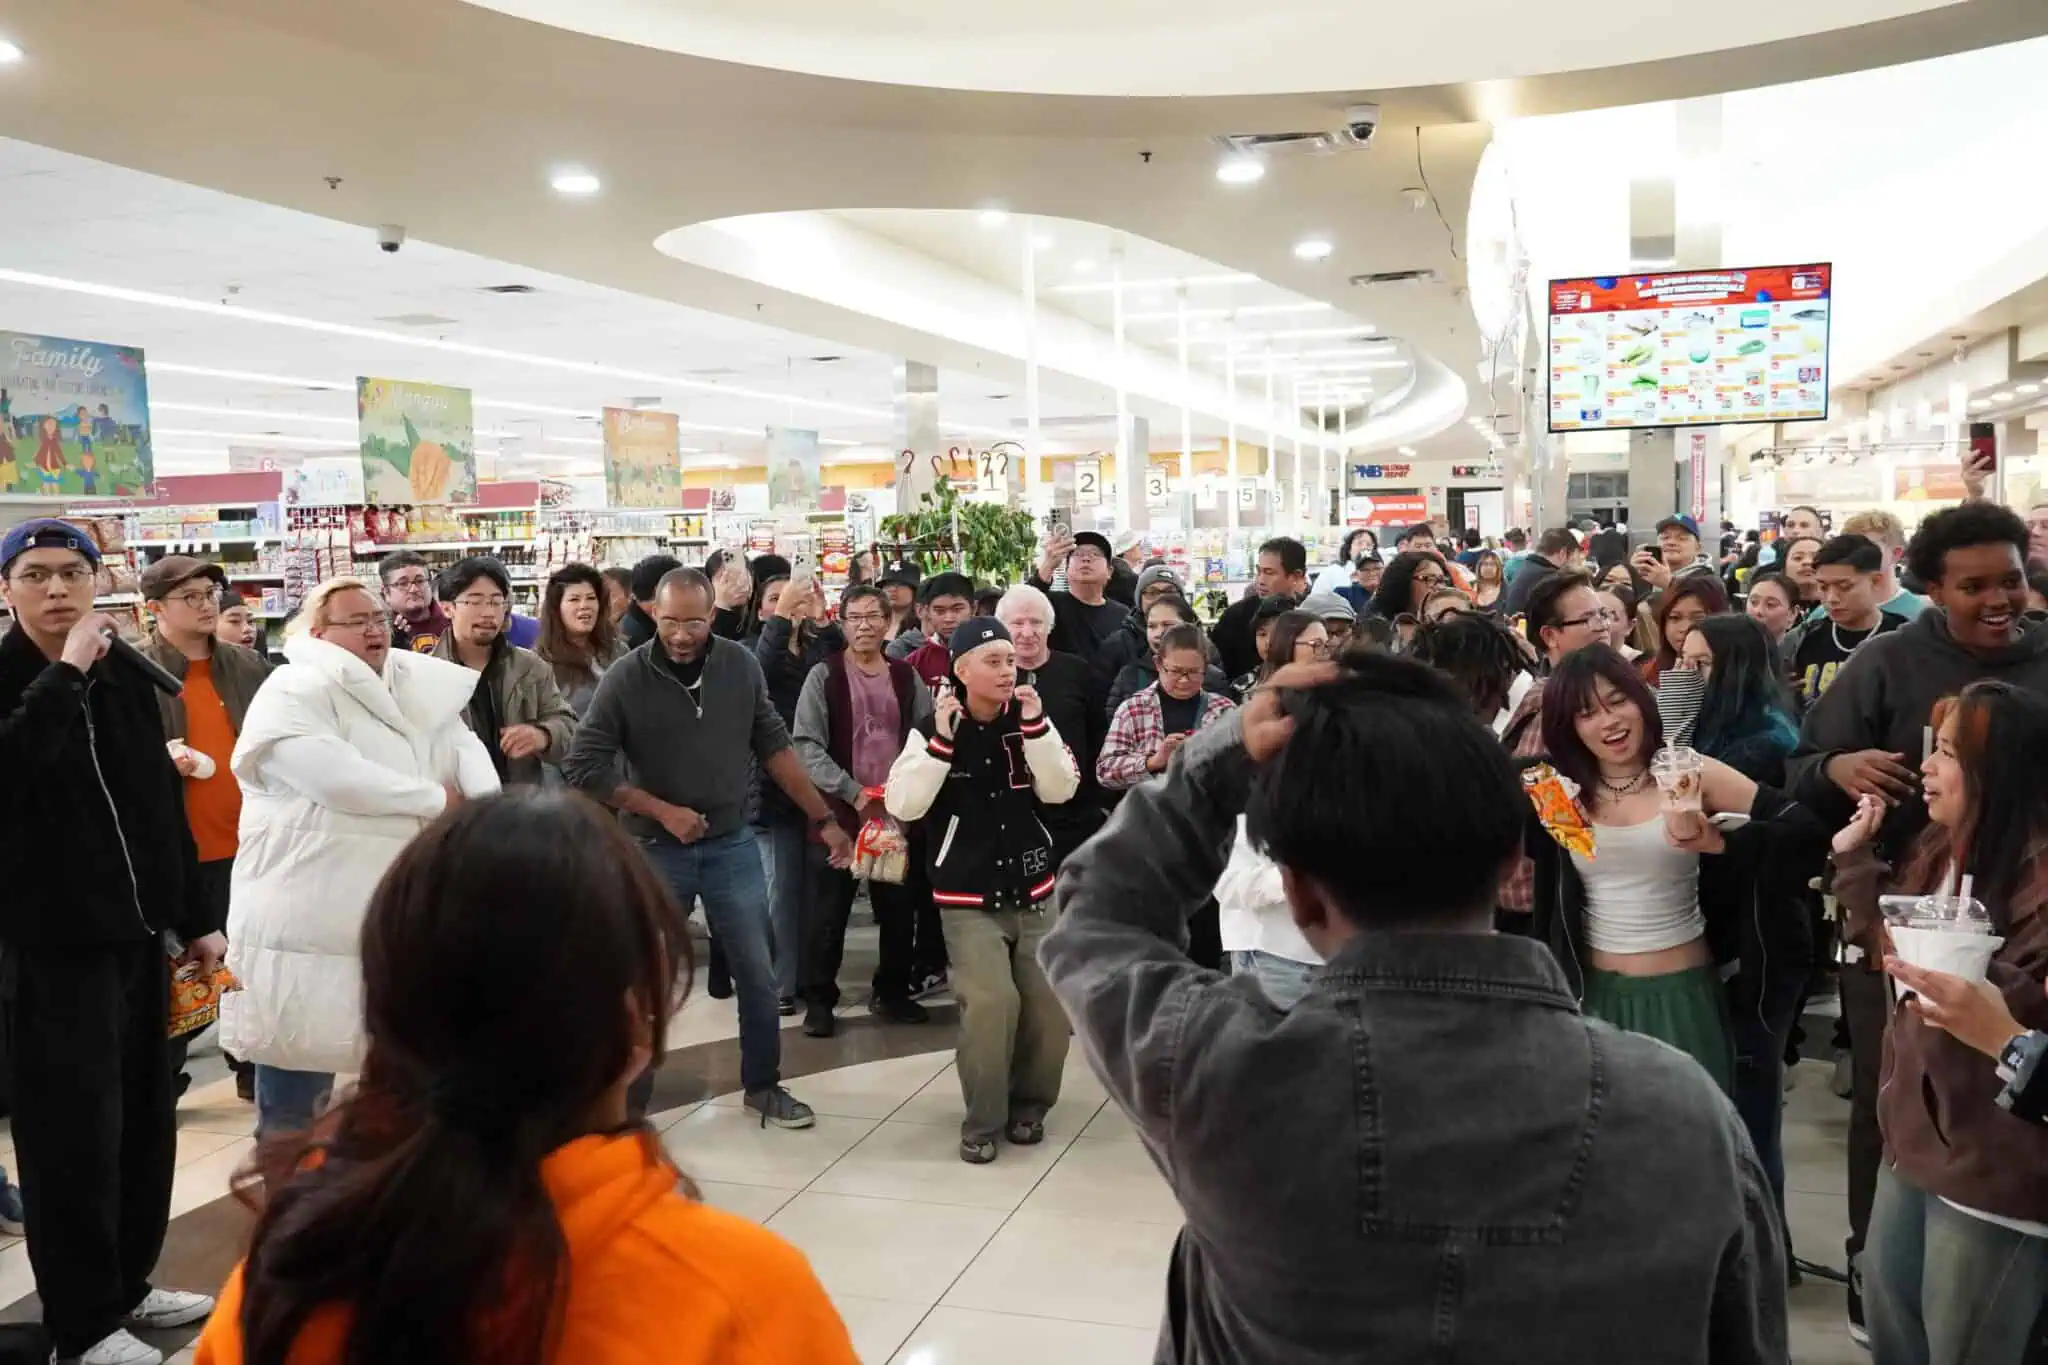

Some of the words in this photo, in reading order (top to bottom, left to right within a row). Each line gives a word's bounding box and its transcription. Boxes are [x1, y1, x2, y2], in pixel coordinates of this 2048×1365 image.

[11, 338, 104, 377] Family
[1080, 473, 1095, 493] 2
[1149, 479, 1162, 496] 3
[1242, 488, 1253, 502] 5
